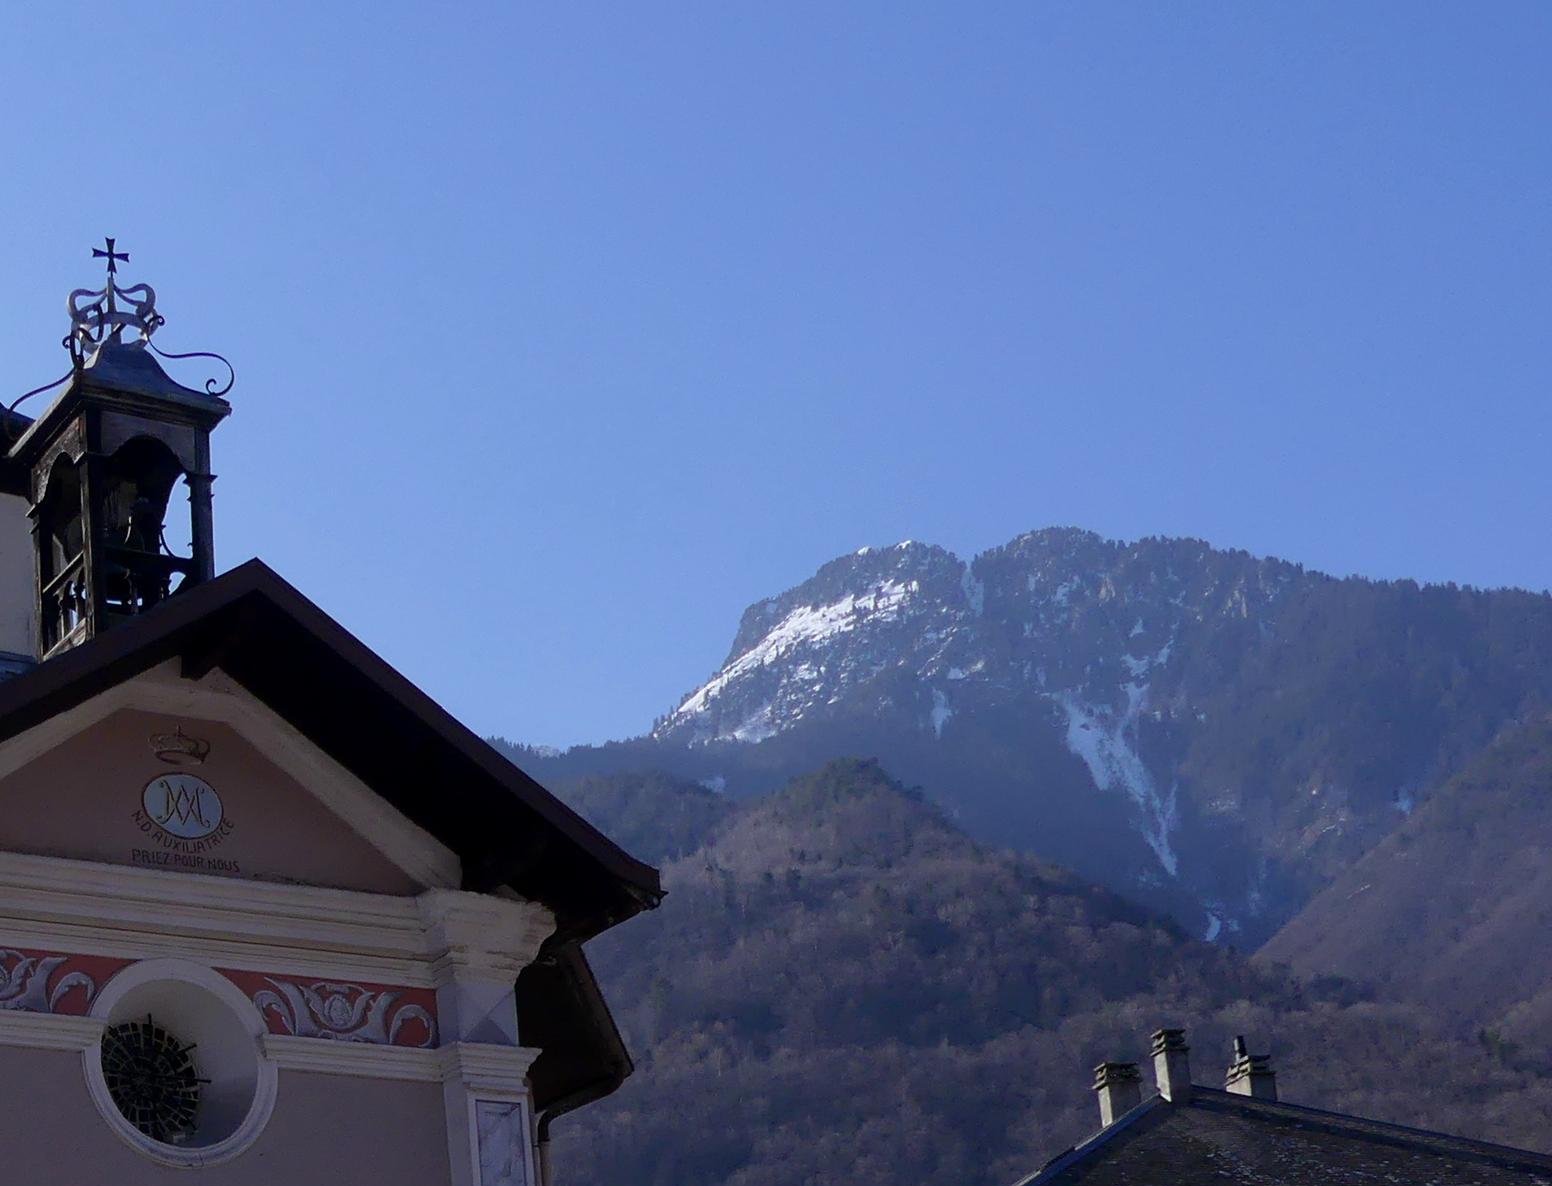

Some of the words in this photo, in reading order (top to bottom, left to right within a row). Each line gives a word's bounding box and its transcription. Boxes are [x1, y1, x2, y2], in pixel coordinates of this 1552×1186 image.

[152, 818, 235, 854] AUXILIATRICE
[131, 848, 169, 865] PRIEZ
[174, 853, 204, 868] POUR
[208, 858, 240, 873] NOUS
